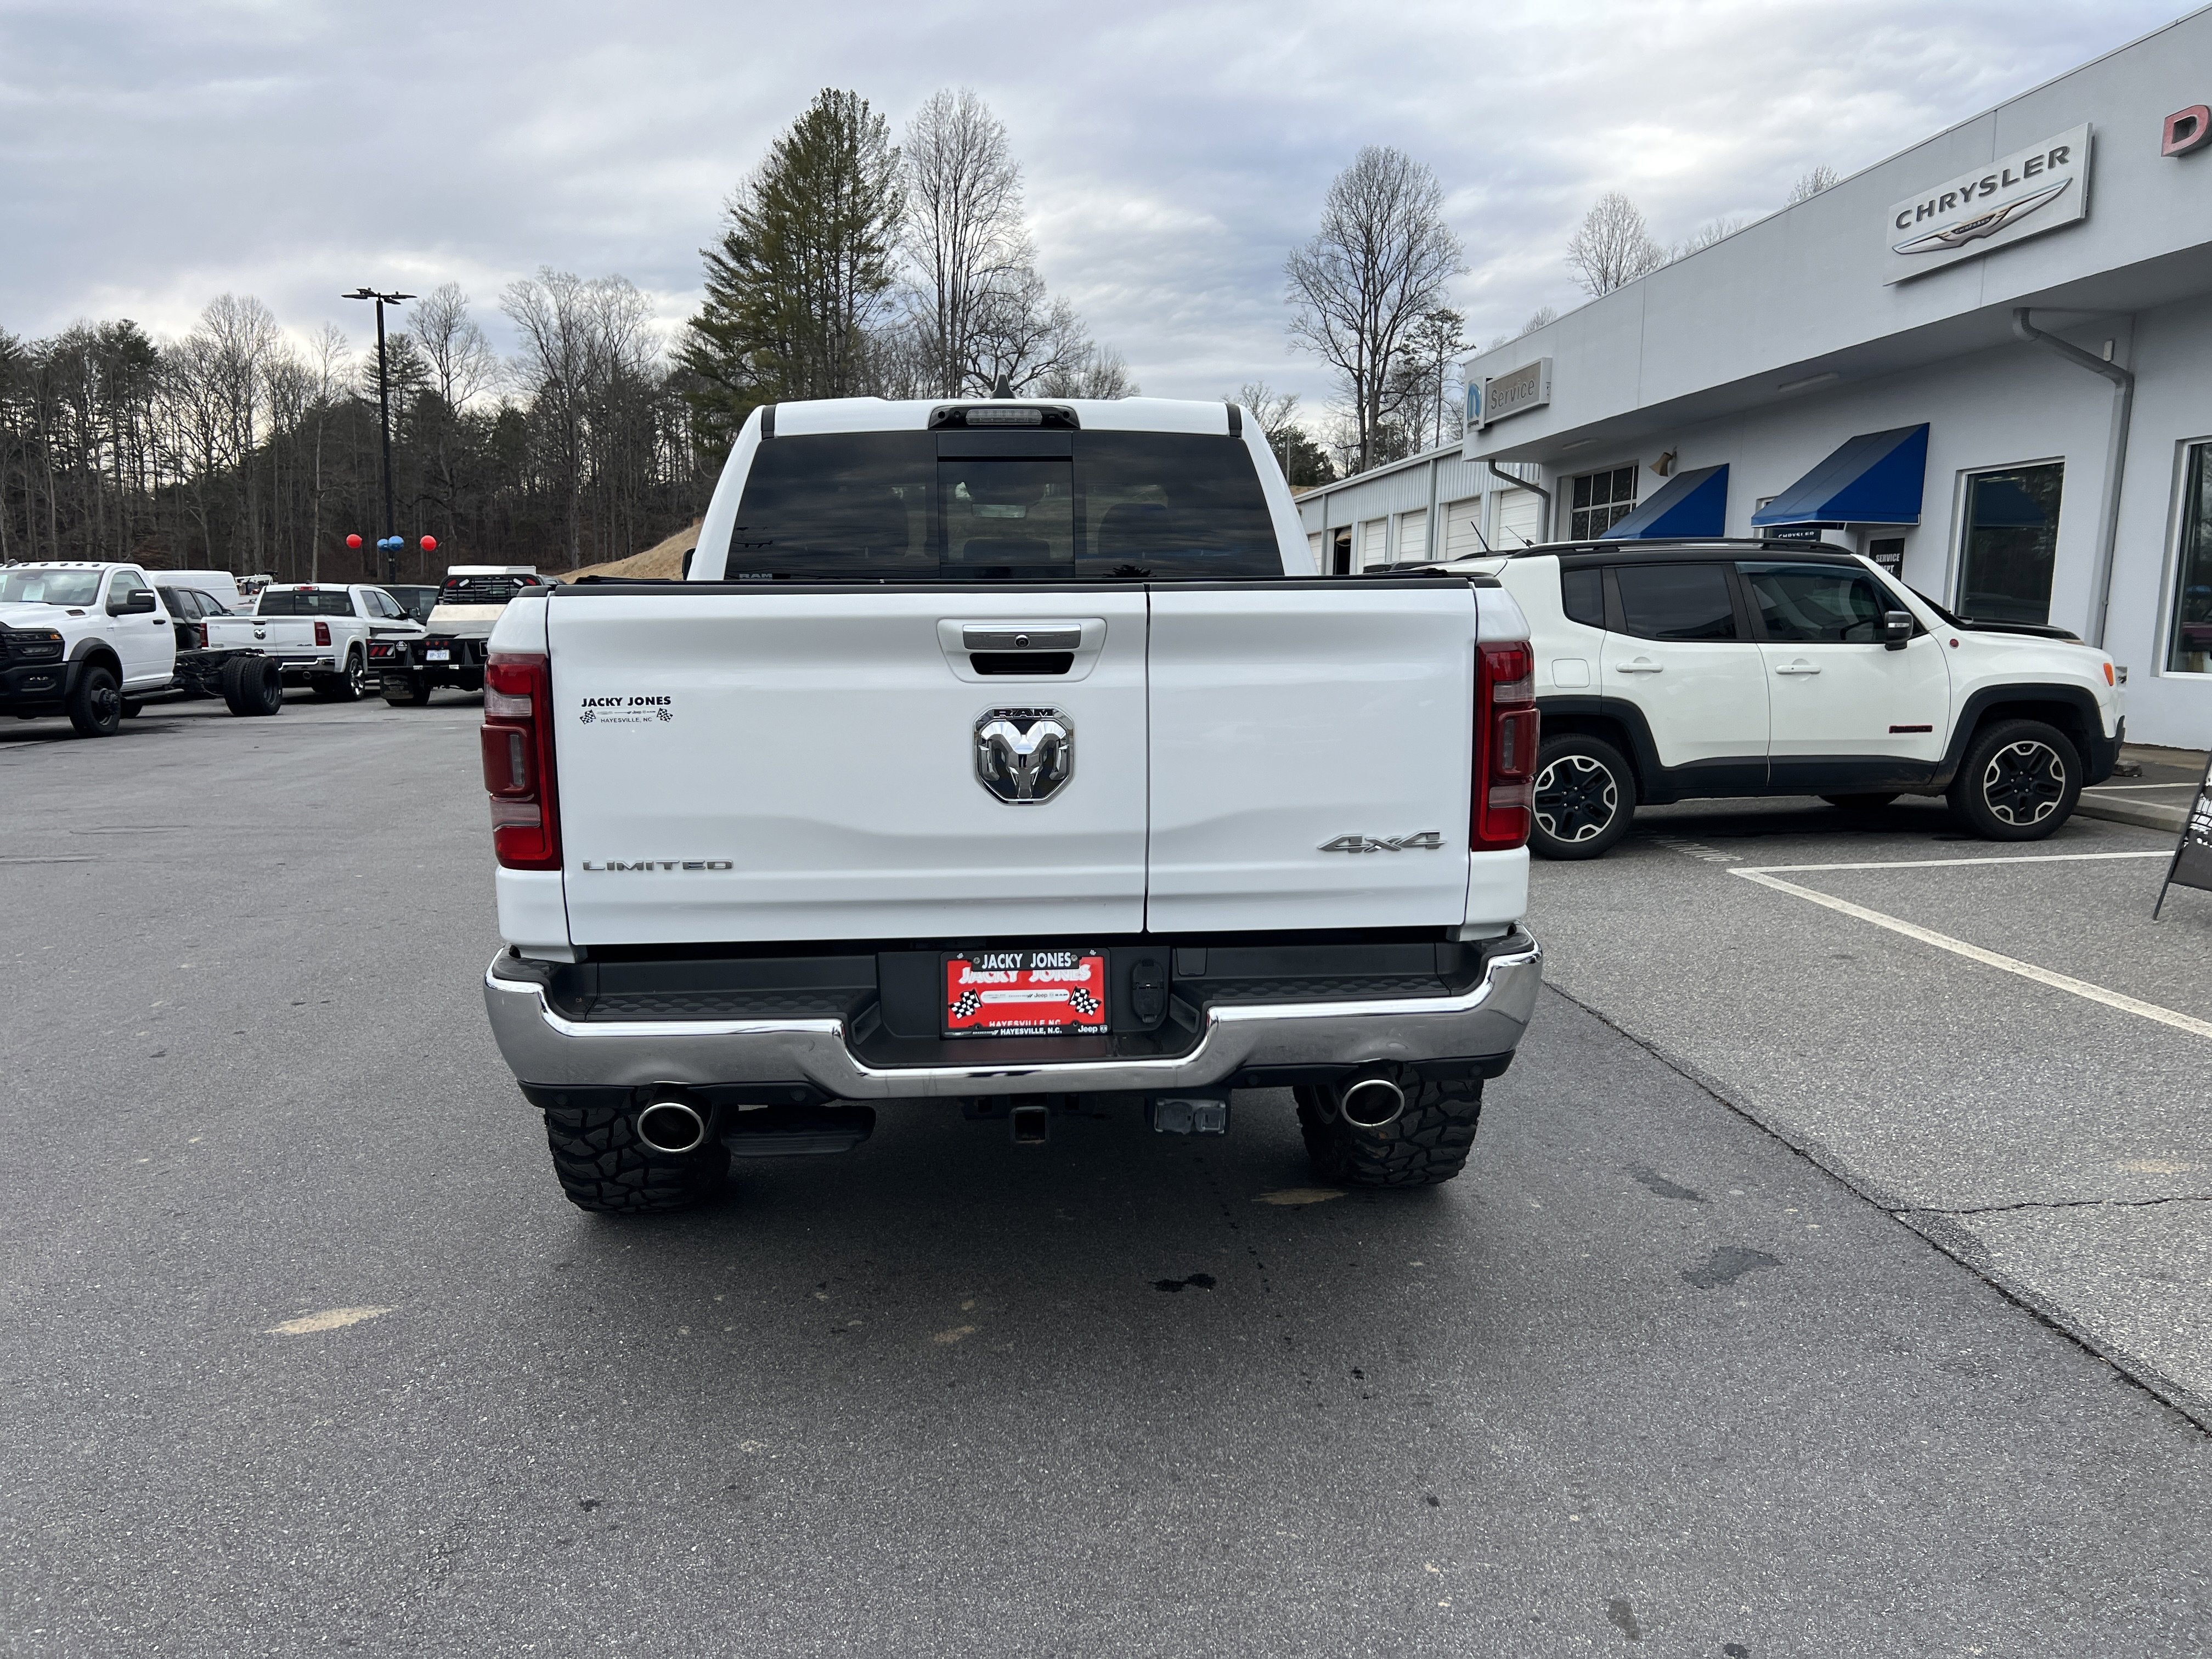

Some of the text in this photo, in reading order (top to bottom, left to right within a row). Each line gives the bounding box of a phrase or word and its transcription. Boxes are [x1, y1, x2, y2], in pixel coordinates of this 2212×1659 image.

[2161, 104, 2211, 157] D
[1895, 145, 2071, 229] CHRYSLER
[1491, 377, 1534, 410] Service
[1875, 553, 1900, 563] SERVICE
[581, 696, 672, 707] JACKY JONES
[994, 708, 1054, 718] RAM
[583, 860, 734, 870] LIMITED
[981, 952, 1071, 969] JACKY JONES
[958, 964, 1091, 984] JACKY JONES
[1000, 1027, 1046, 1035] HAYESVILLE,
[1077, 1025, 1098, 1034] Jeep
